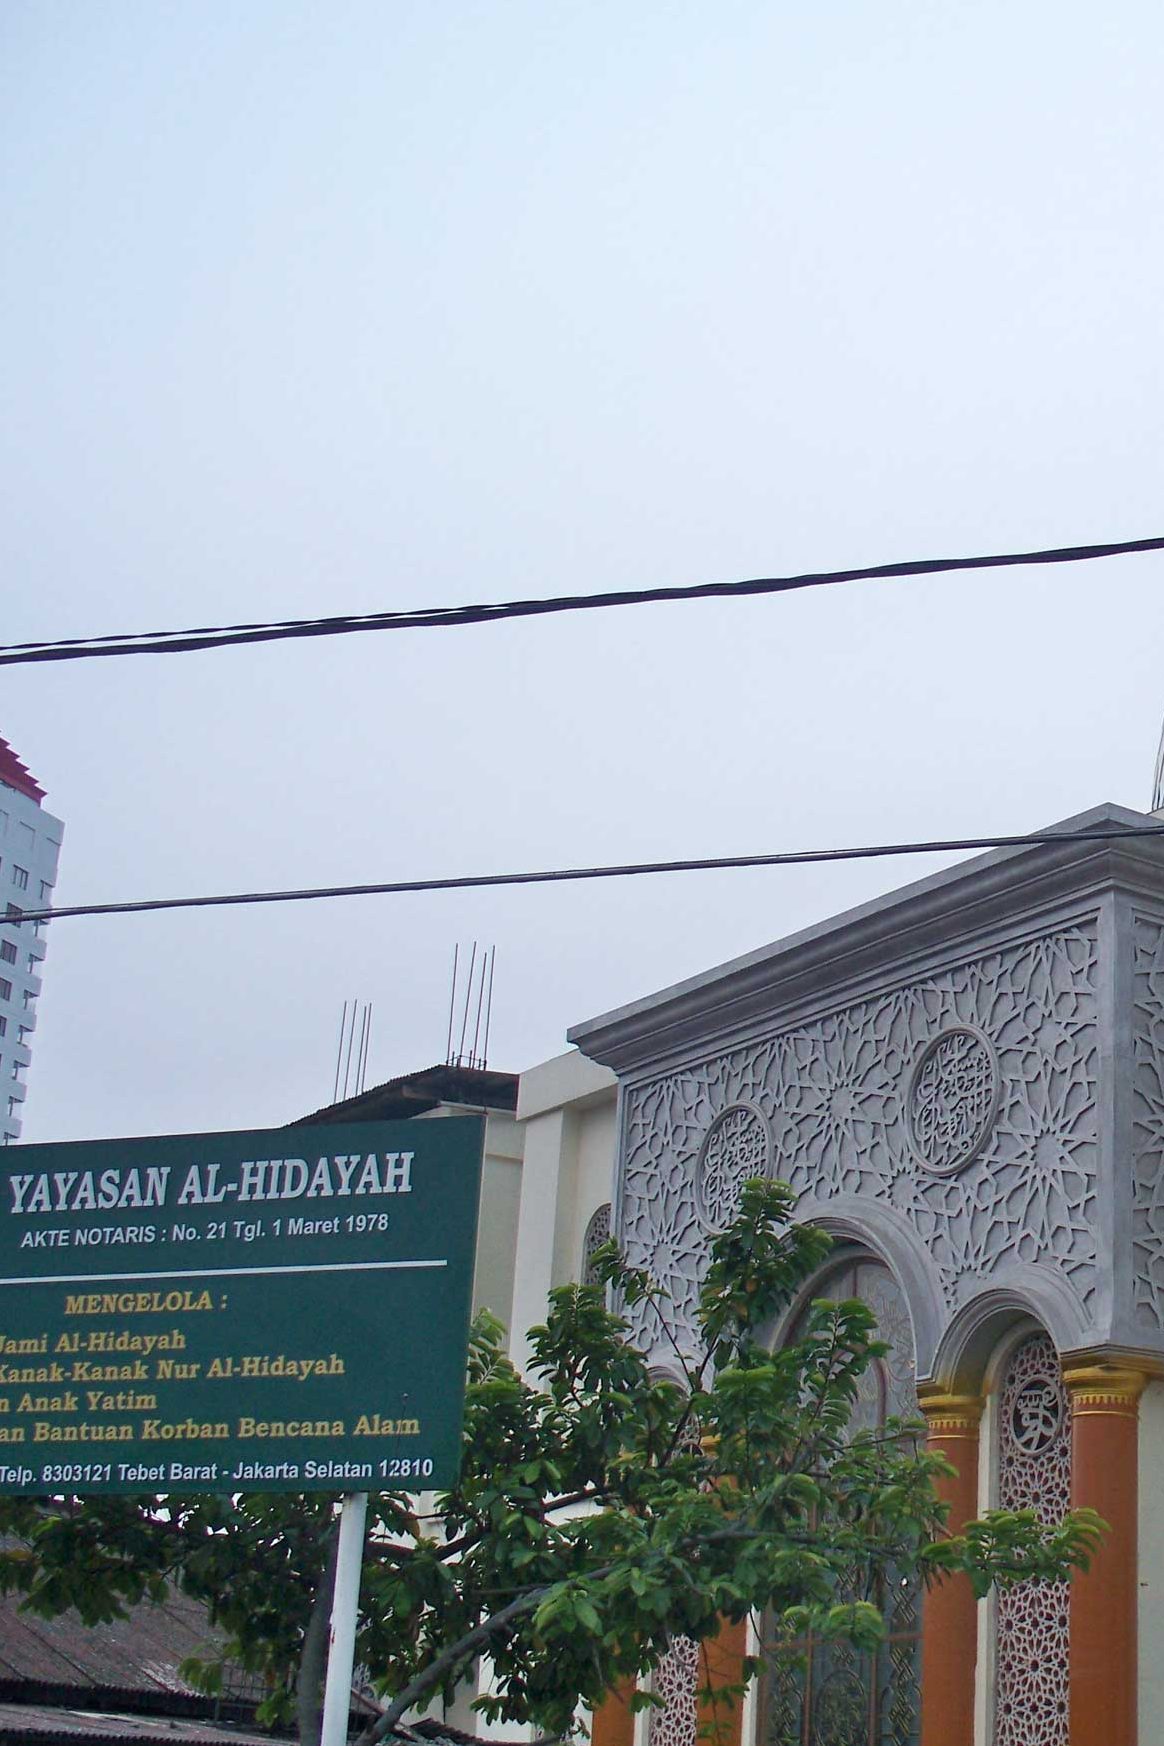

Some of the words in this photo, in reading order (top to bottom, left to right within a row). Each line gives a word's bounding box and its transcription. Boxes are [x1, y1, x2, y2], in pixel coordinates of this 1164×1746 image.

[9, 1166, 172, 1214] YAYASAN
[177, 1152, 415, 1205] AL-HIDAYAH
[20, 1228, 71, 1248] AKTE
[75, 1225, 156, 1245] NOTARIS
[172, 1223, 201, 1242] No.
[206, 1221, 227, 1239] 21
[233, 1219, 266, 1242] Tgl.
[272, 1219, 281, 1236] 1
[287, 1217, 340, 1235] Maret
[345, 1213, 389, 1232] 1978
[64, 1290, 214, 1315] MENGELOLA
[54, 1328, 187, 1356] Al-Hidayah
[156, 1359, 201, 1380] Nur
[206, 1352, 345, 1382] Al-Hidayah
[16, 1390, 79, 1413] Anak
[86, 1389, 158, 1411] Yatim
[33, 1421, 134, 1443] Bantuan
[142, 1417, 229, 1441] Korban
[237, 1416, 345, 1438] Bencana
[352, 1413, 421, 1436] Alam
[0, 1465, 37, 1487] Telp.
[42, 1463, 112, 1482] 8303121
[117, 1463, 166, 1481] Tebet
[170, 1462, 217, 1481] Barat
[233, 1461, 299, 1480] Jakarta
[304, 1460, 373, 1478] Selatan
[379, 1458, 434, 1477] 12810
